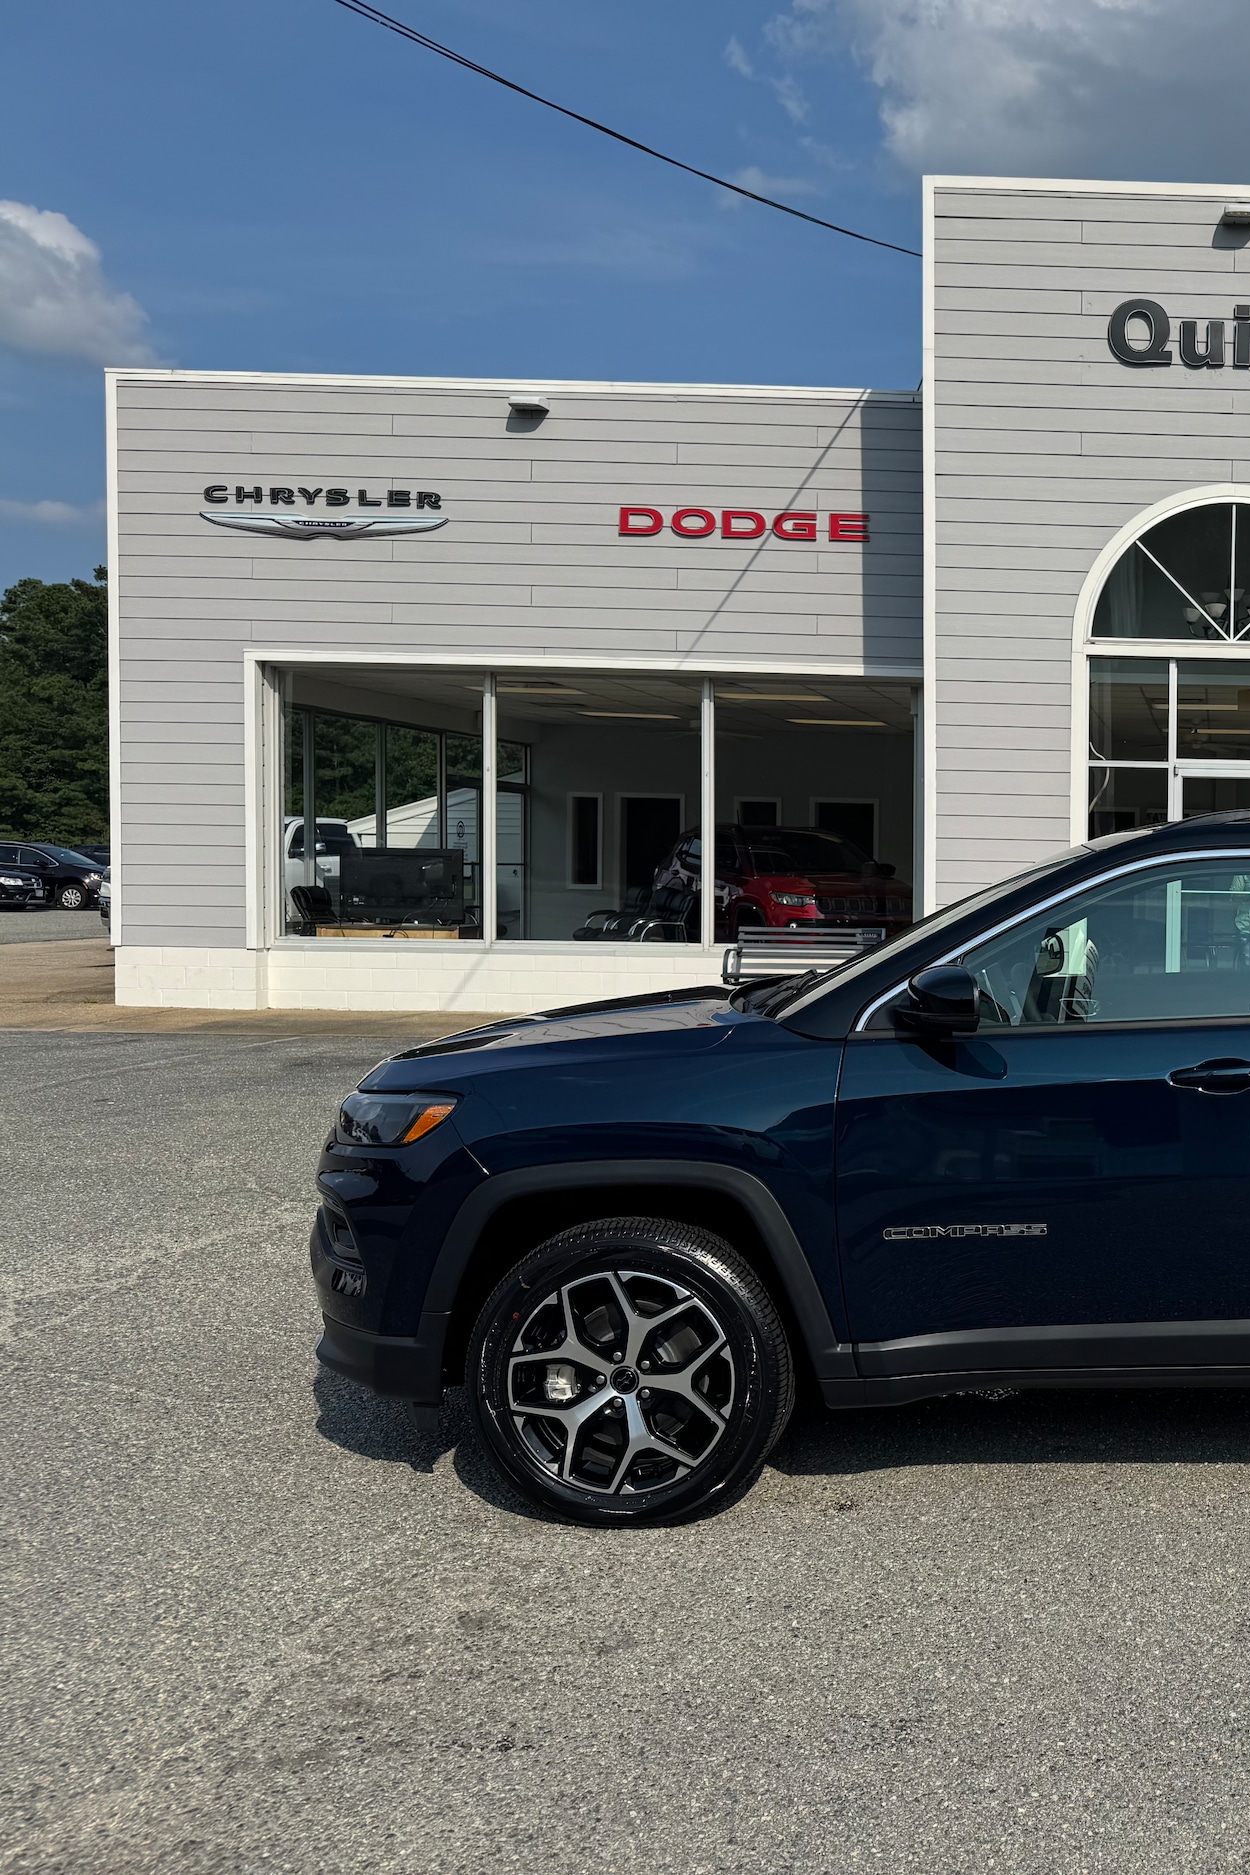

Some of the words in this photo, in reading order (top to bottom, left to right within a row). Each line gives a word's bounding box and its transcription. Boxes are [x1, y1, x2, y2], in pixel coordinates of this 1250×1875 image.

[203, 484, 442, 509] CHRYSLER
[618, 506, 871, 542] DODGE
[883, 1223, 1048, 1240] COMPASS
